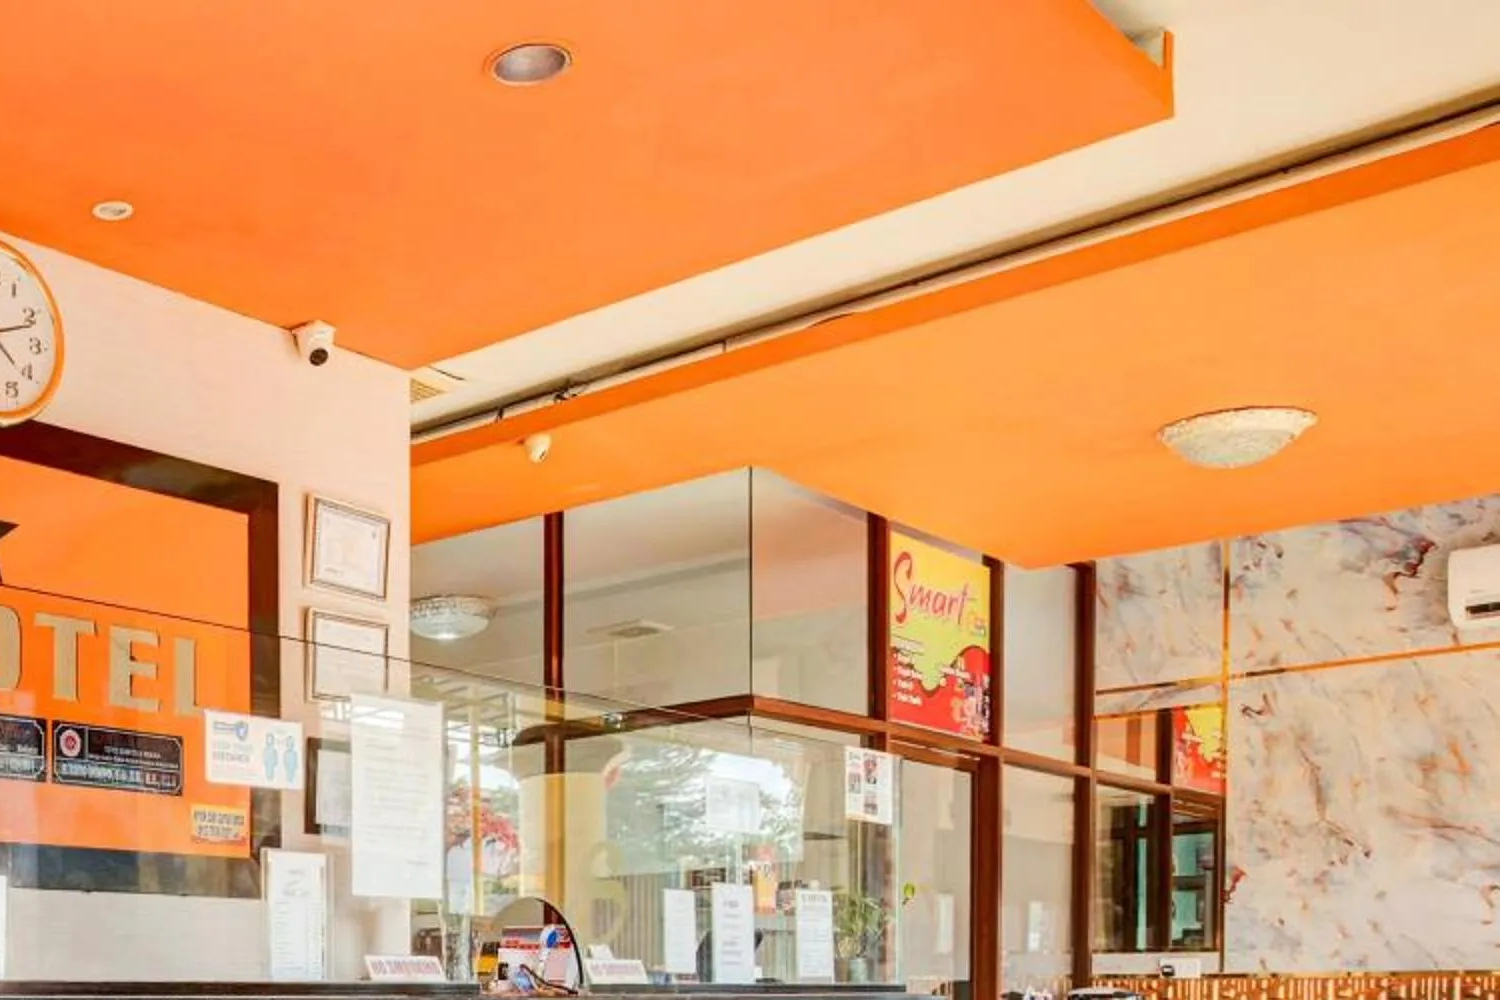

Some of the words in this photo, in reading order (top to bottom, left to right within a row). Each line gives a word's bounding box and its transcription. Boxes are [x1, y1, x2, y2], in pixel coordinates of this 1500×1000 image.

[11, 283, 17, 298] 1
[22, 307, 36, 325] 2
[29, 337, 41, 355] 3
[21, 364, 33, 381] 4
[5, 381, 19, 398] 5
[893, 551, 976, 625] Smart
